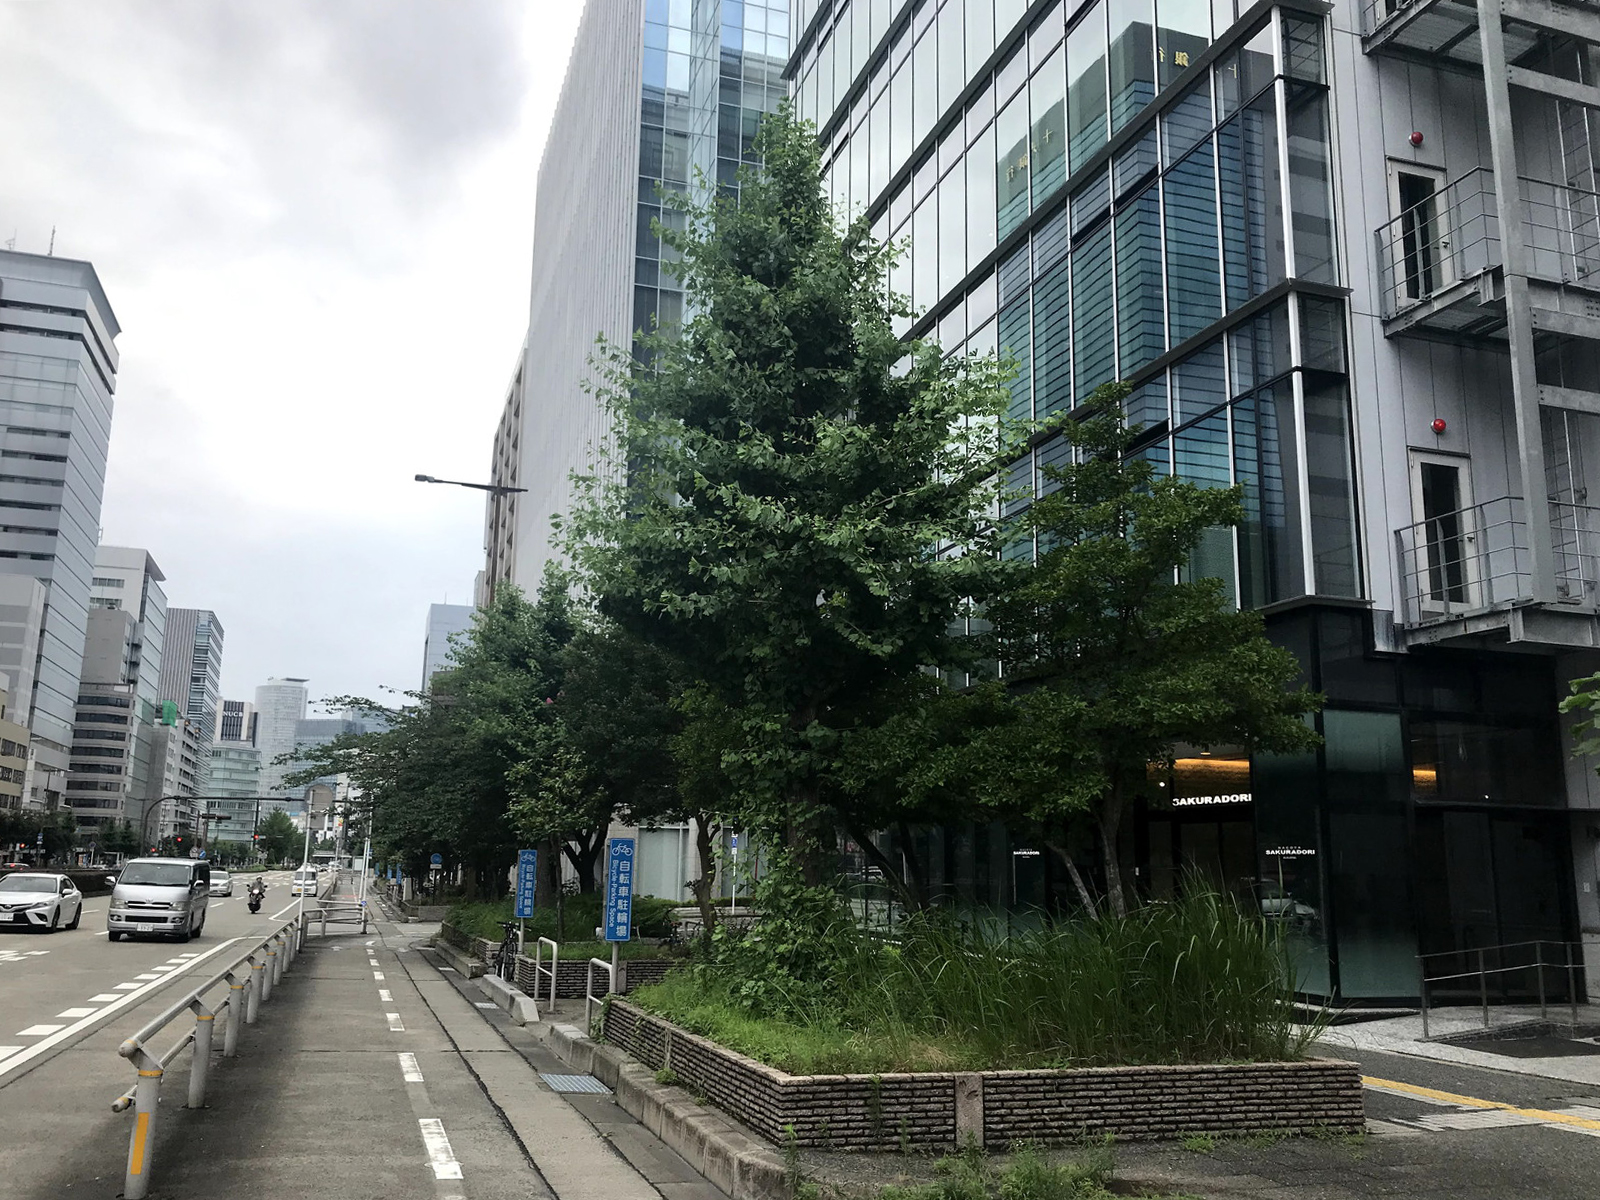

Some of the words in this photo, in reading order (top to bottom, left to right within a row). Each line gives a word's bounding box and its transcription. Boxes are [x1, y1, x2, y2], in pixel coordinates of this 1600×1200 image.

[1172, 794, 1252, 806] SAKURADORI
[523, 865, 534, 915] 自転車駐輪場
[616, 861, 631, 937] 自転車駐輪場
[609, 908, 617, 928] Space
